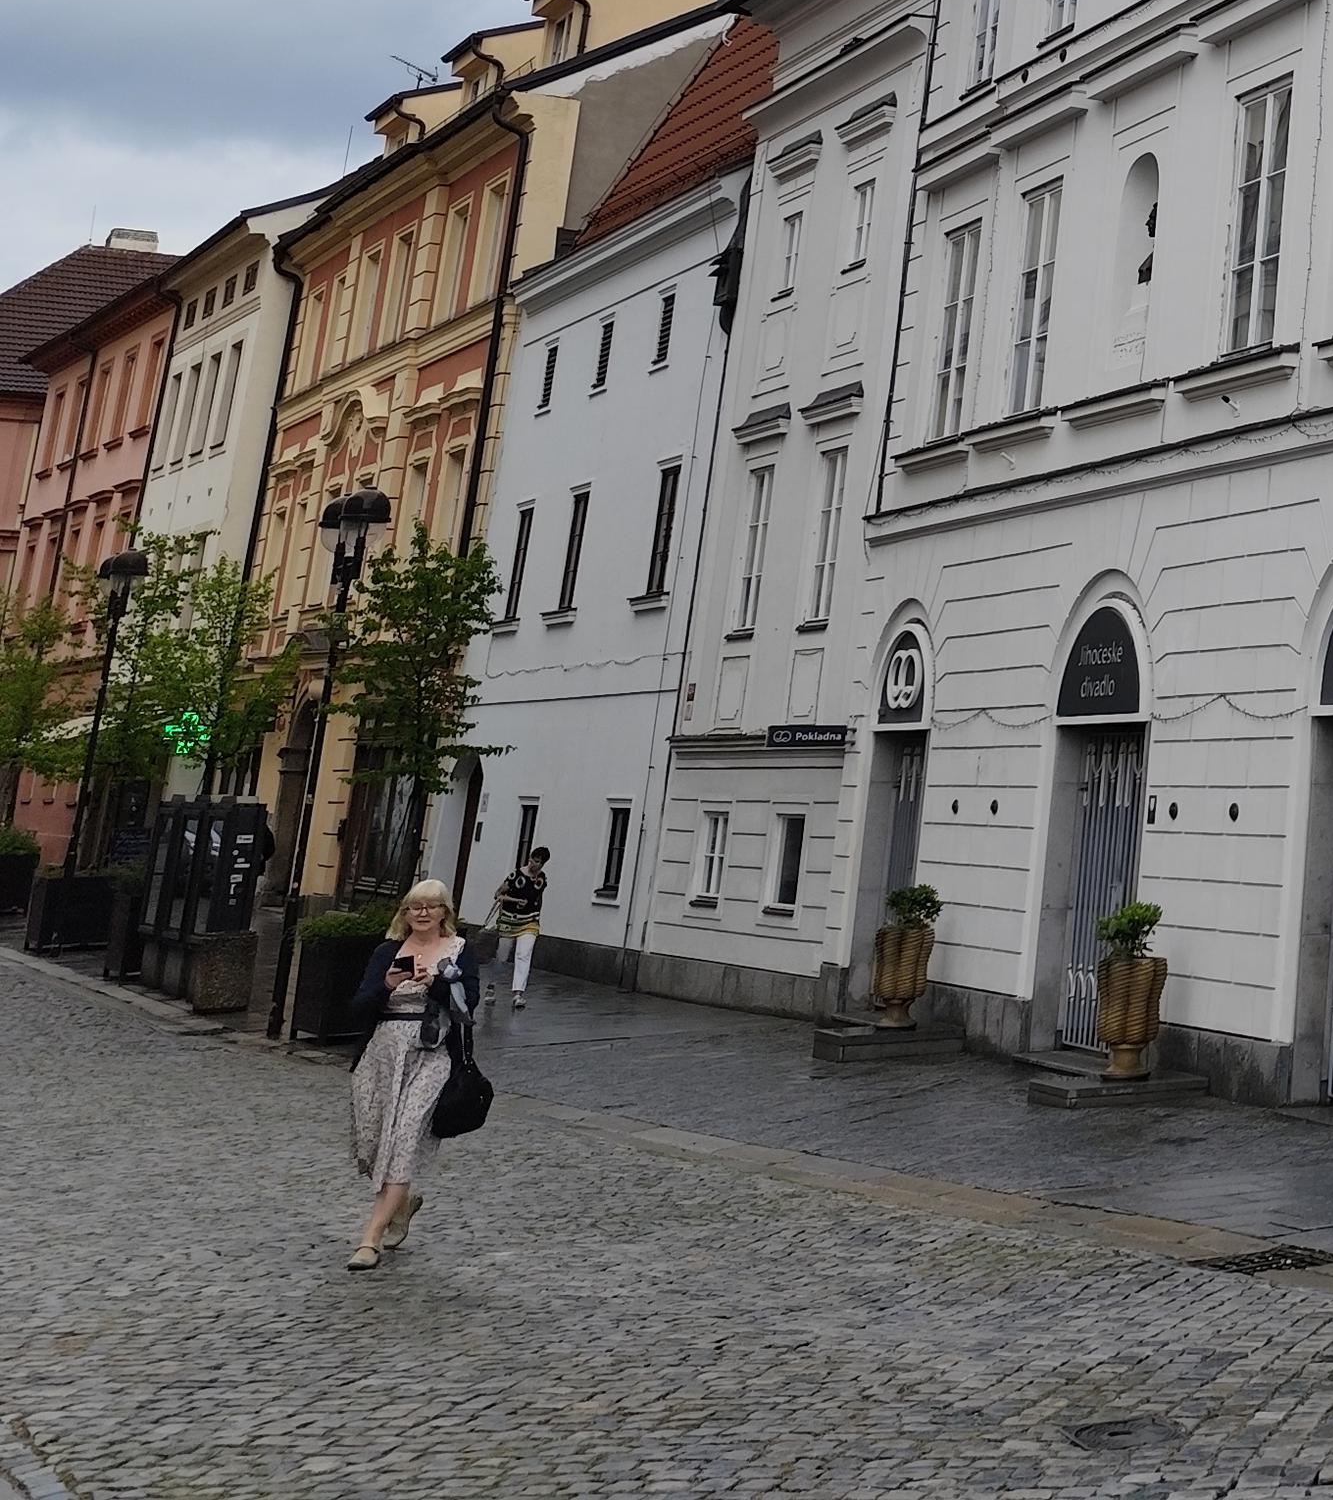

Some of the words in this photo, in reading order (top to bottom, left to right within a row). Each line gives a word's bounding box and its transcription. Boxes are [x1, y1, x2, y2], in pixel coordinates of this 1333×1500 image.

[1078, 640, 1123, 666] Jihočeské
[1080, 674, 1115, 697] divadlo
[795, 732, 842, 741] Pokladna
